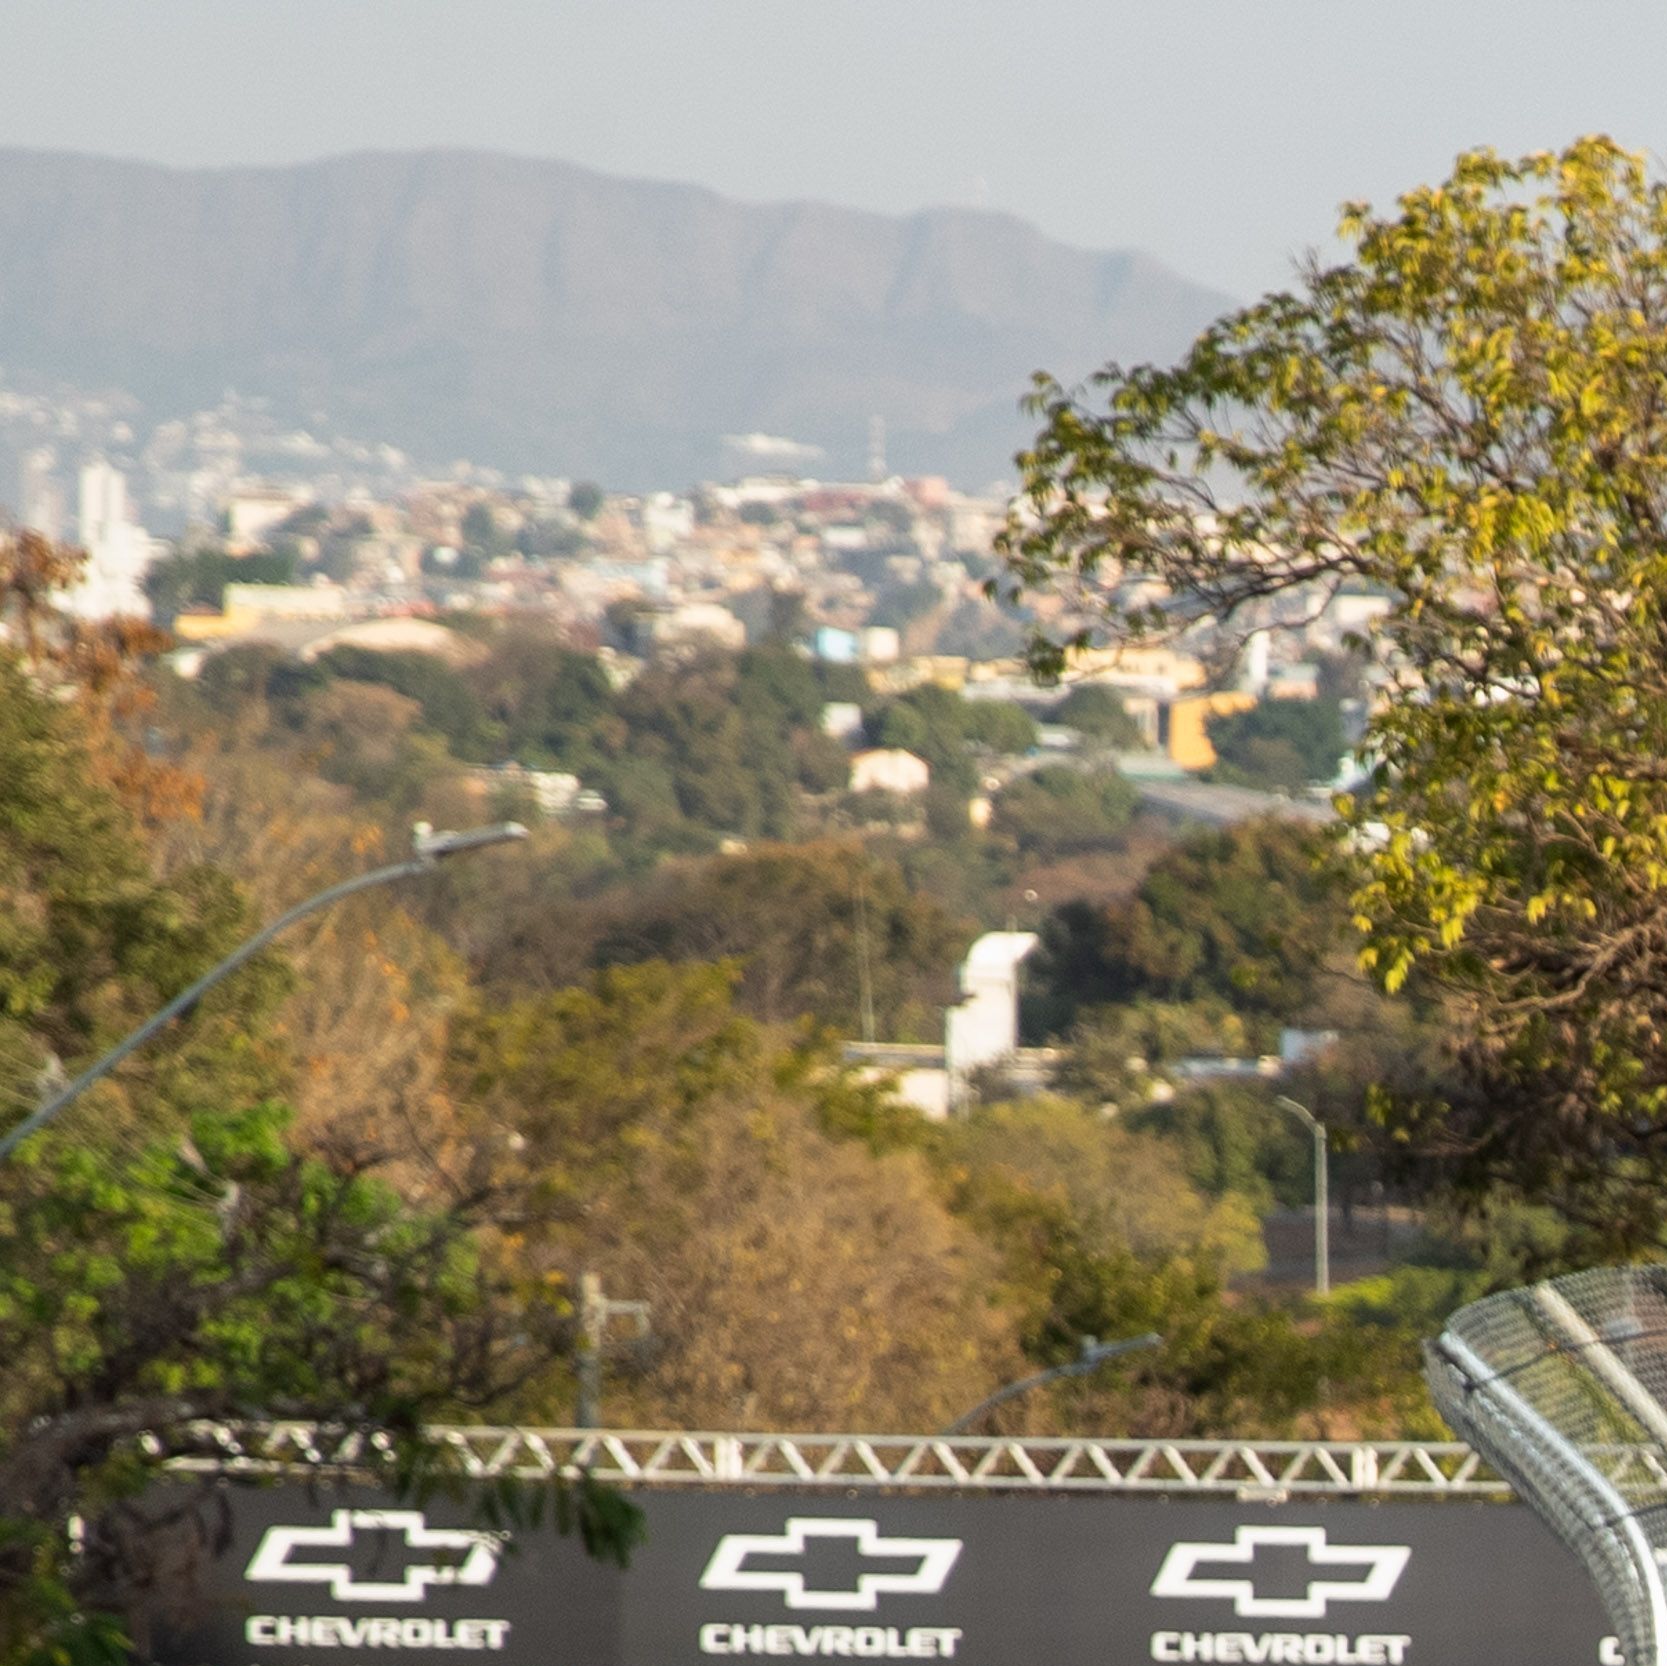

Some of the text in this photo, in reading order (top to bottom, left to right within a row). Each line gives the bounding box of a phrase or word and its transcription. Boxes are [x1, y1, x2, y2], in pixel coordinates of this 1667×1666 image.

[246, 1615, 511, 1650] CHEVROLET
[700, 1622, 963, 1659] CHEVROLET
[1149, 1630, 1411, 1666] CHEVROLET
